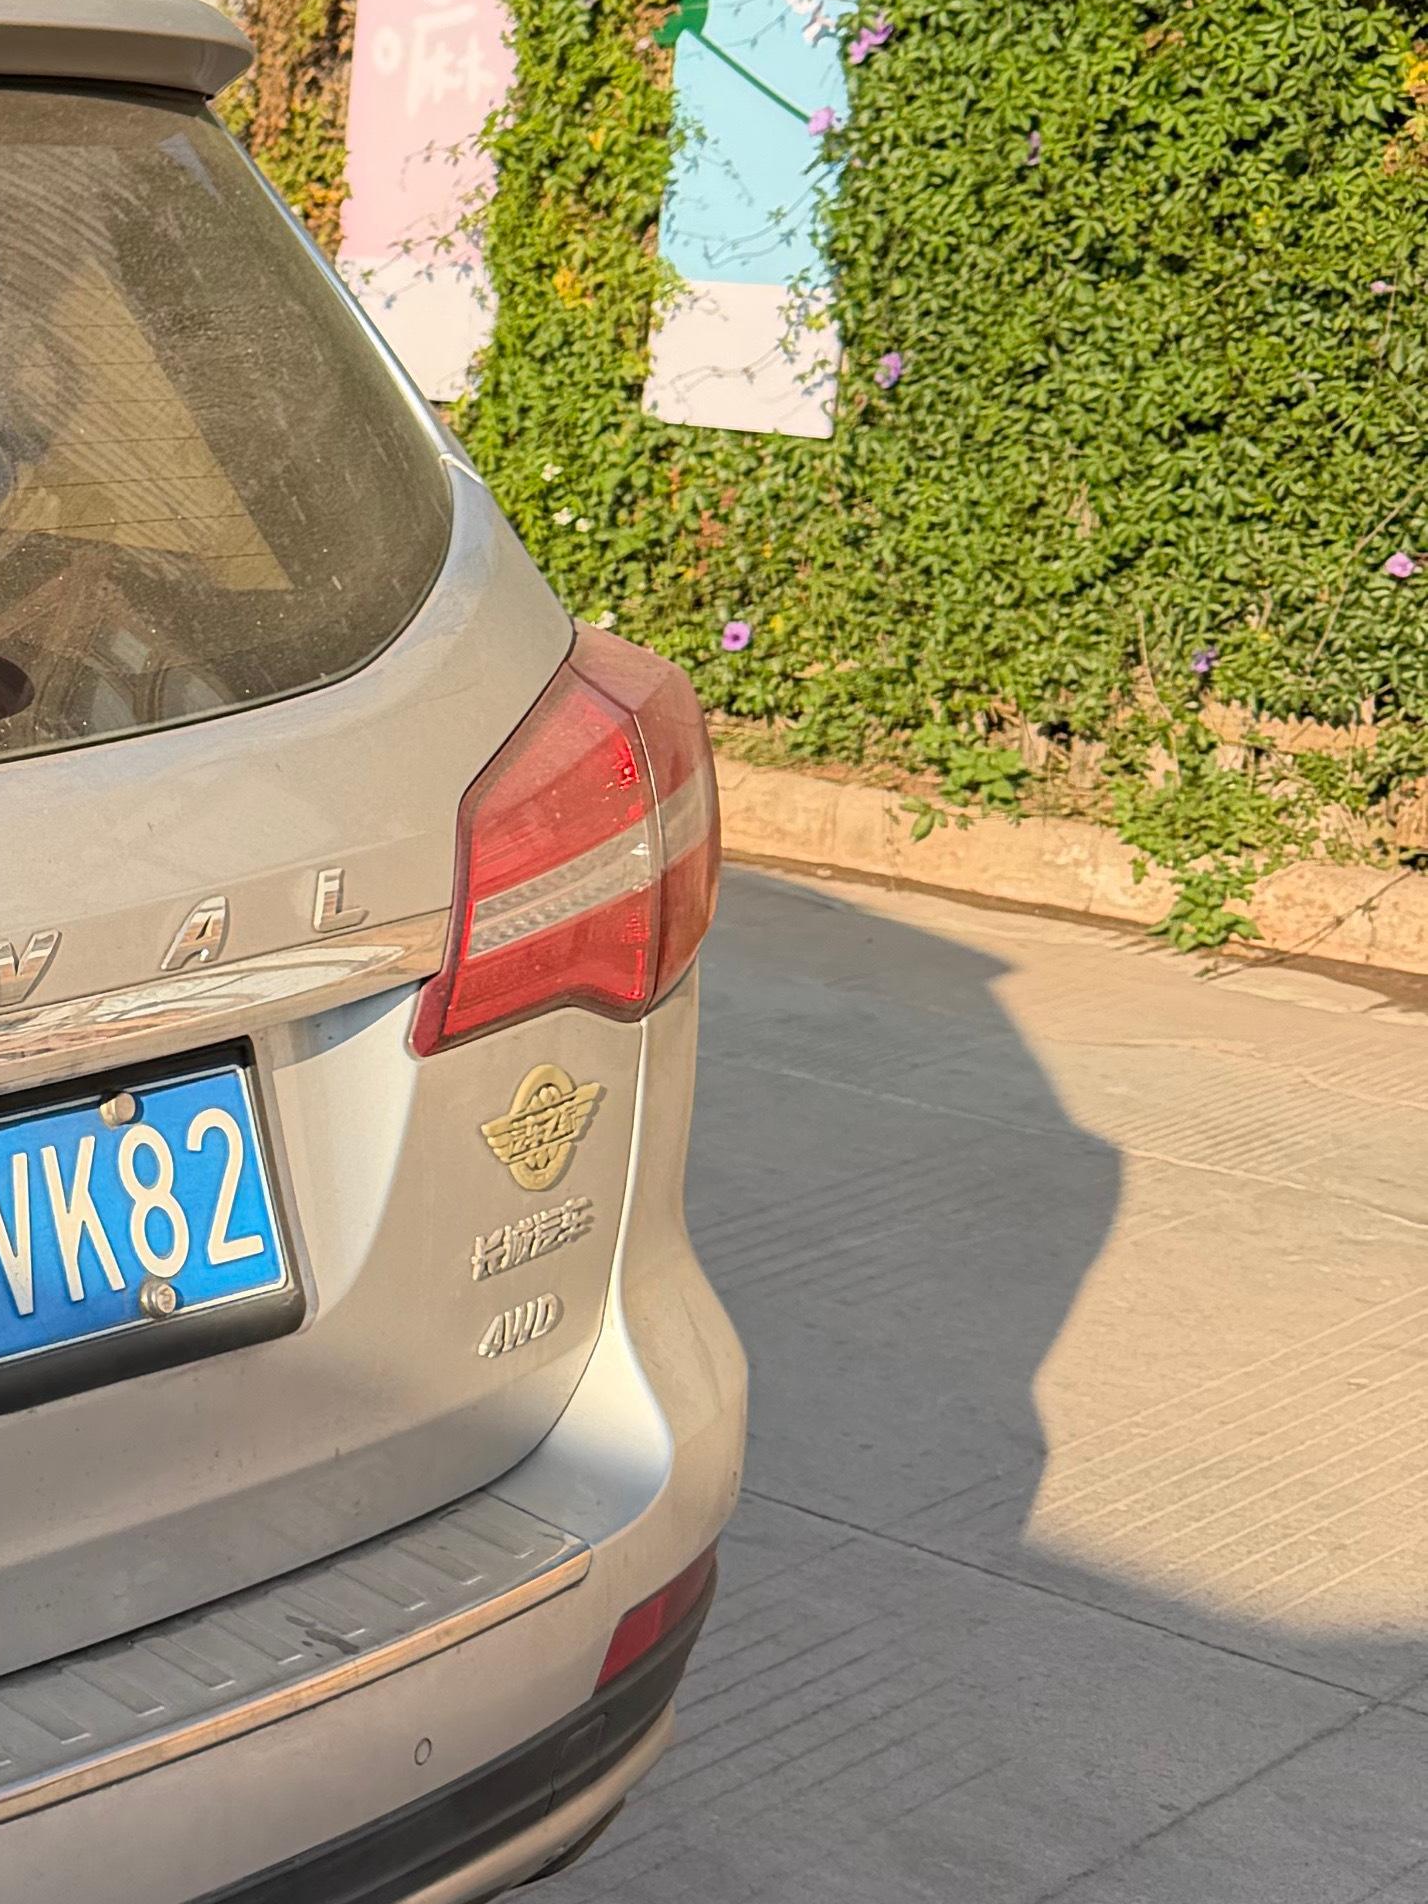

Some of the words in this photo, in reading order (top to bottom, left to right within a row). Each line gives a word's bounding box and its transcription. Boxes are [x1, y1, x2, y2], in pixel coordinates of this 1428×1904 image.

[471, 1197, 594, 1281] 长城汽车
[478, 1293, 562, 1359] 4WD
